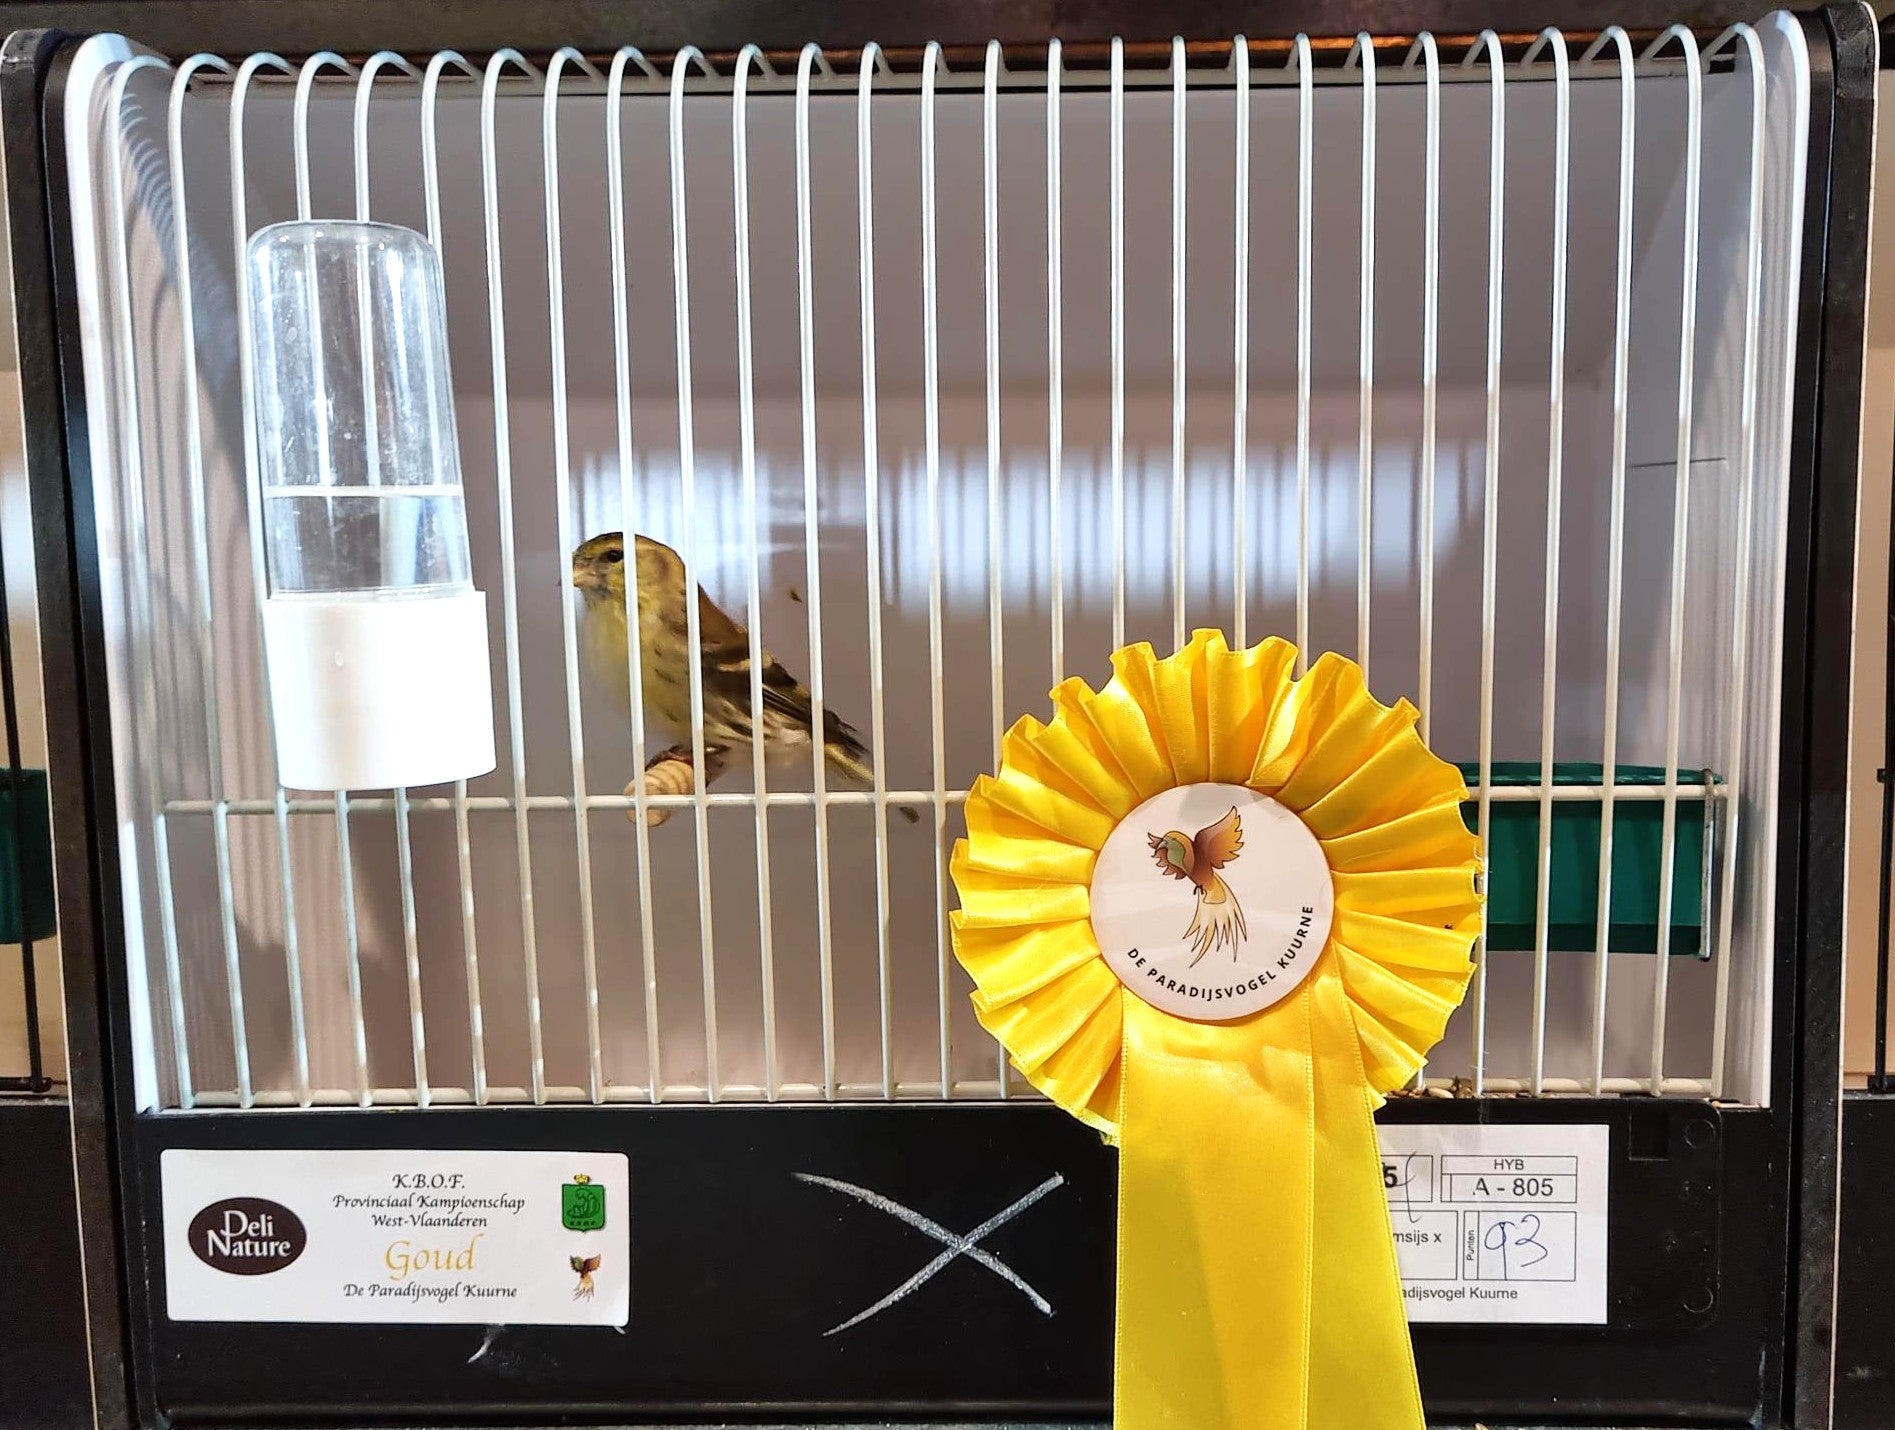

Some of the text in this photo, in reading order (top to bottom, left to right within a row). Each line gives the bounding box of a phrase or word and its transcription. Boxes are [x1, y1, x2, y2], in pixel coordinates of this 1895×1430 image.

[1128, 906, 1313, 1002] DE PARADIJSVOGEL KUURNE
[1494, 1159, 1524, 1171] HYB
[392, 1174, 466, 1189] K.B.O.F.
[1474, 1178, 1490, 1196] A
[1513, 1178, 1553, 1196] 805
[333, 1192, 525, 1214] Provinciaal Kampioenschap
[221, 1210, 274, 1238] Deli
[371, 1212, 488, 1228] West-Vlaanderen
[207, 1230, 292, 1258] Nature
[1433, 1233, 1442, 1243] x
[1484, 1214, 1548, 1280] 93
[385, 1233, 485, 1281] Goud
[343, 1281, 517, 1303] De Paradijsvogel Kuurne
